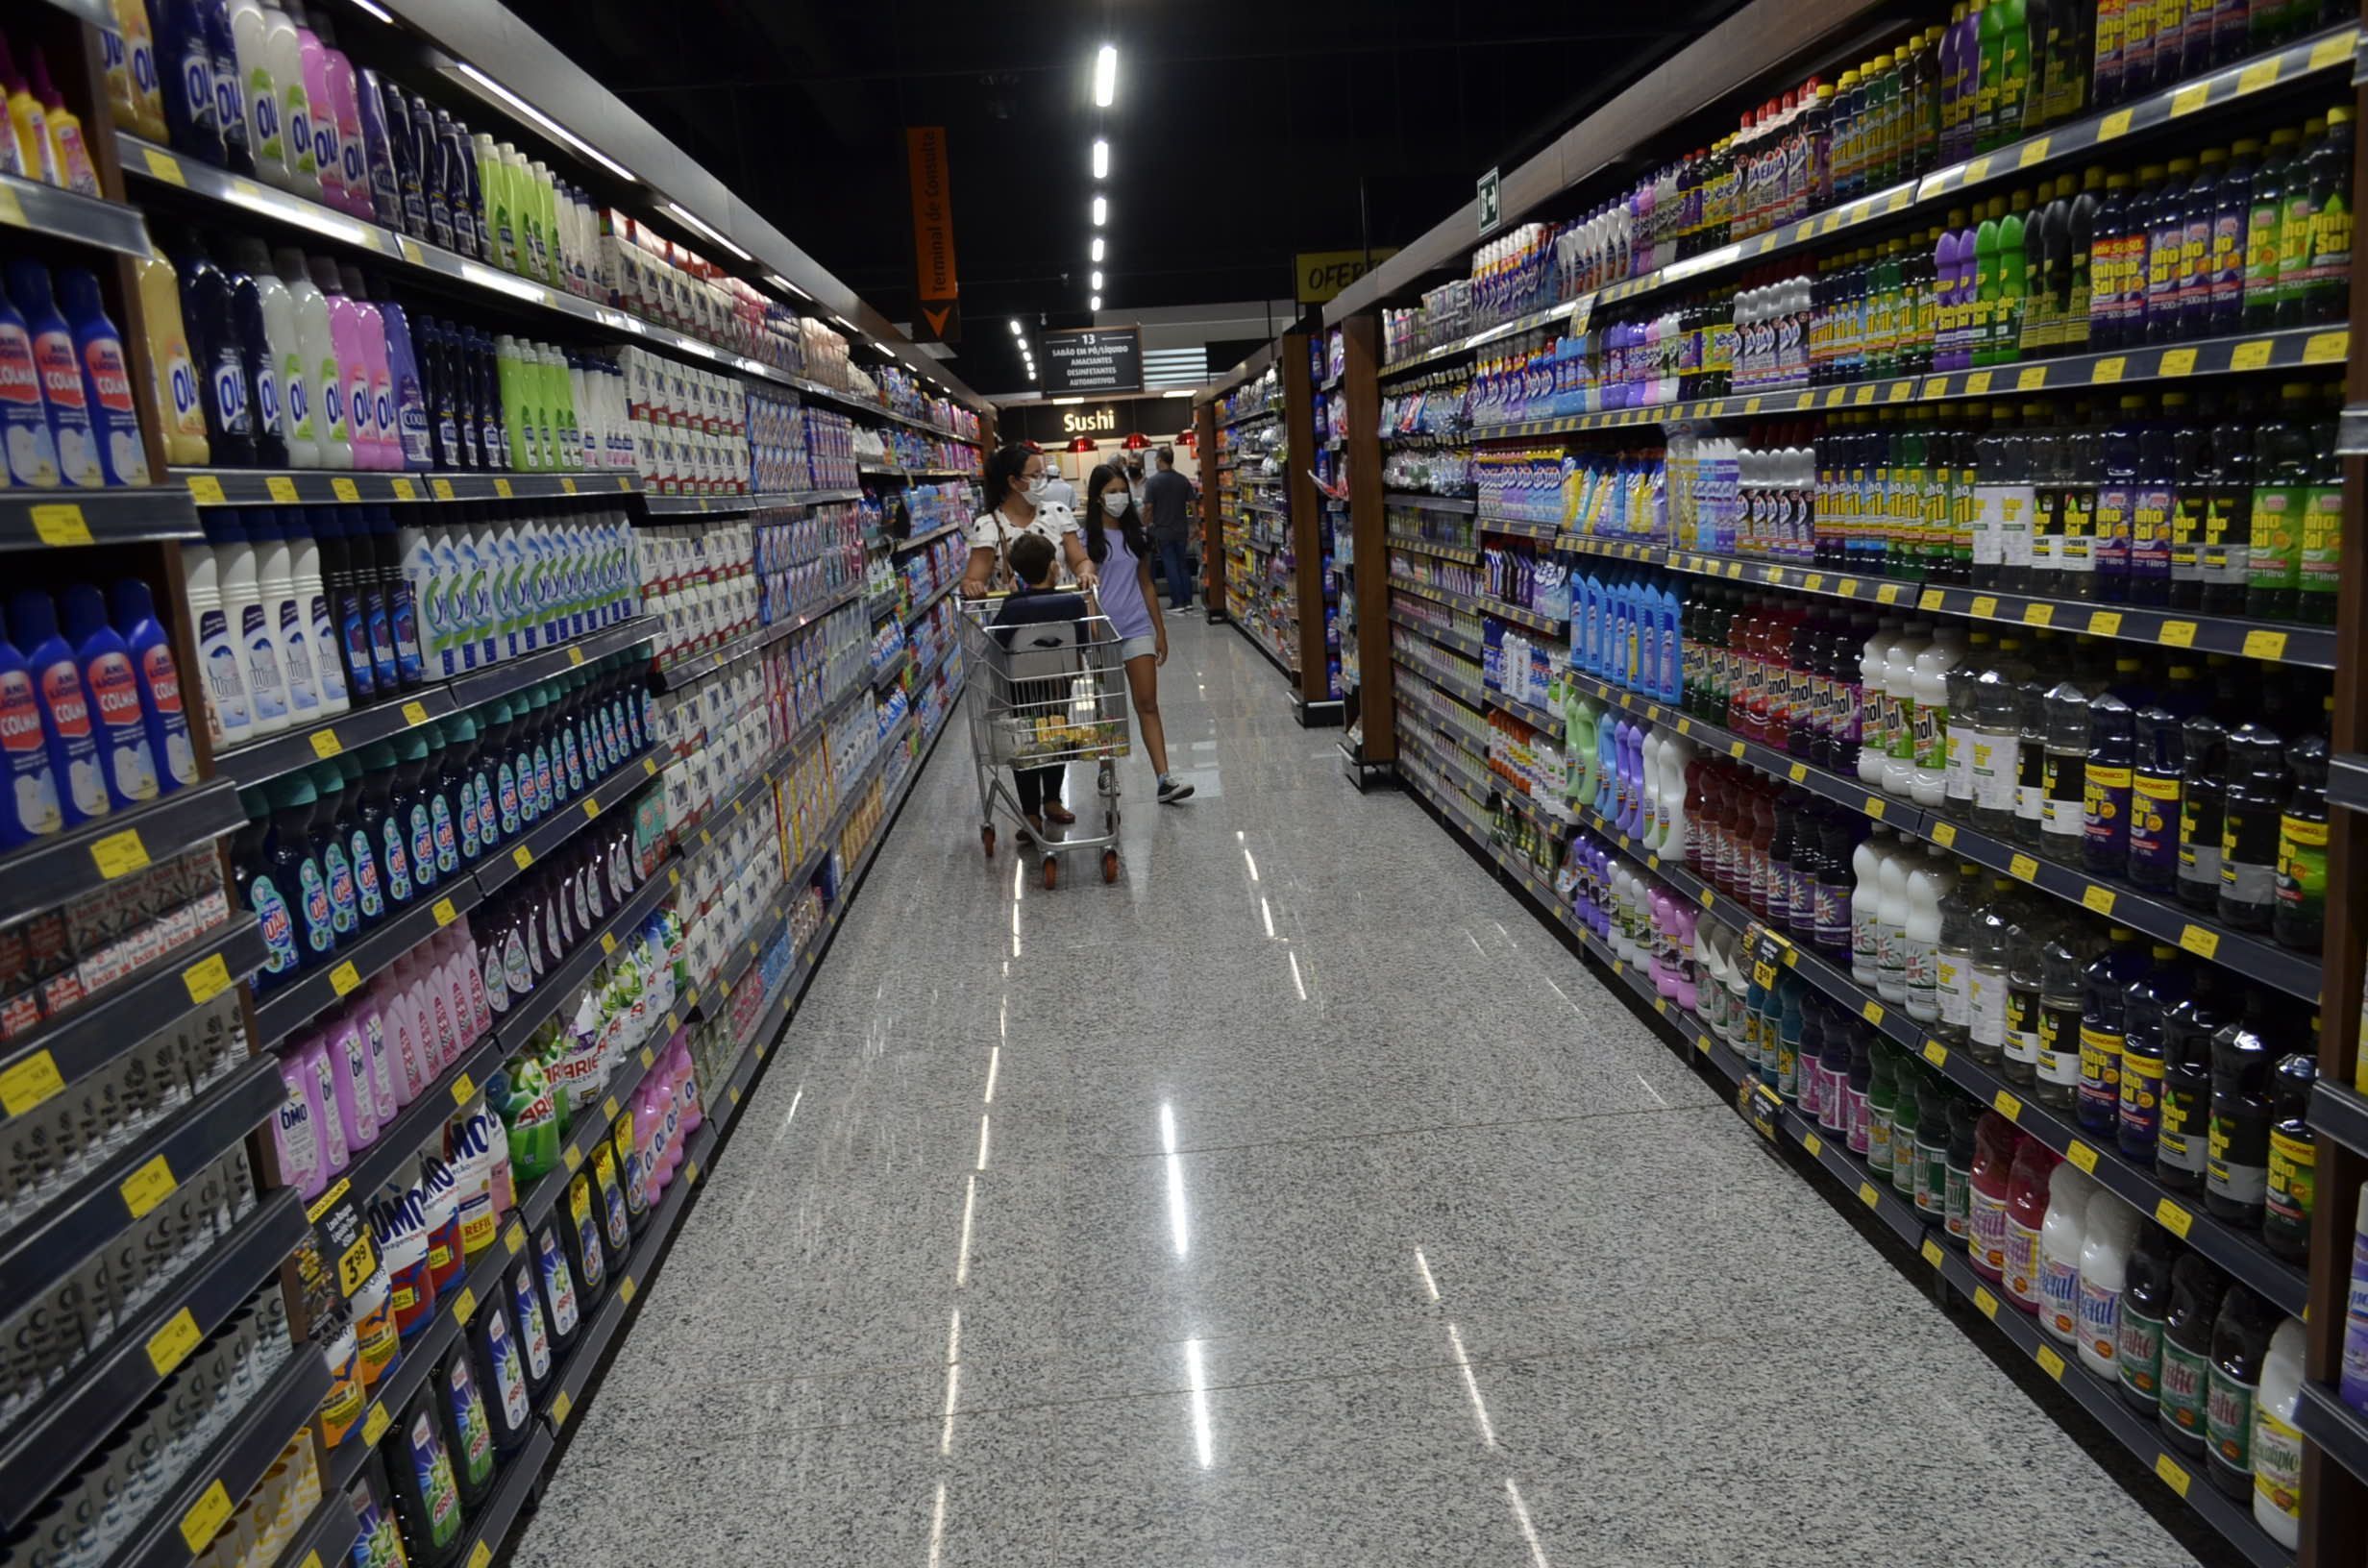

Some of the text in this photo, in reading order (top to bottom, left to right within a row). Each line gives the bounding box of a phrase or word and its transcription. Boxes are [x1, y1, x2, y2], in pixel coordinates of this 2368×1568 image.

[925, 203, 941, 222] de
[927, 230, 947, 292] Terminal
[1082, 334, 1097, 345] 13
[1067, 366, 1117, 377] DESINFETANTES
[1071, 356, 1113, 366] AMACIANTES
[1063, 409, 1116, 432] Sushi
[1747, 663, 1764, 687] nol
[1768, 670, 1790, 694] anol
[1790, 676, 1813, 701] anol
[1833, 688, 1851, 714] nol
[1862, 695, 1882, 722] nol
[1913, 711, 1933, 740] nol
[367, 1188, 426, 1244] OMO
